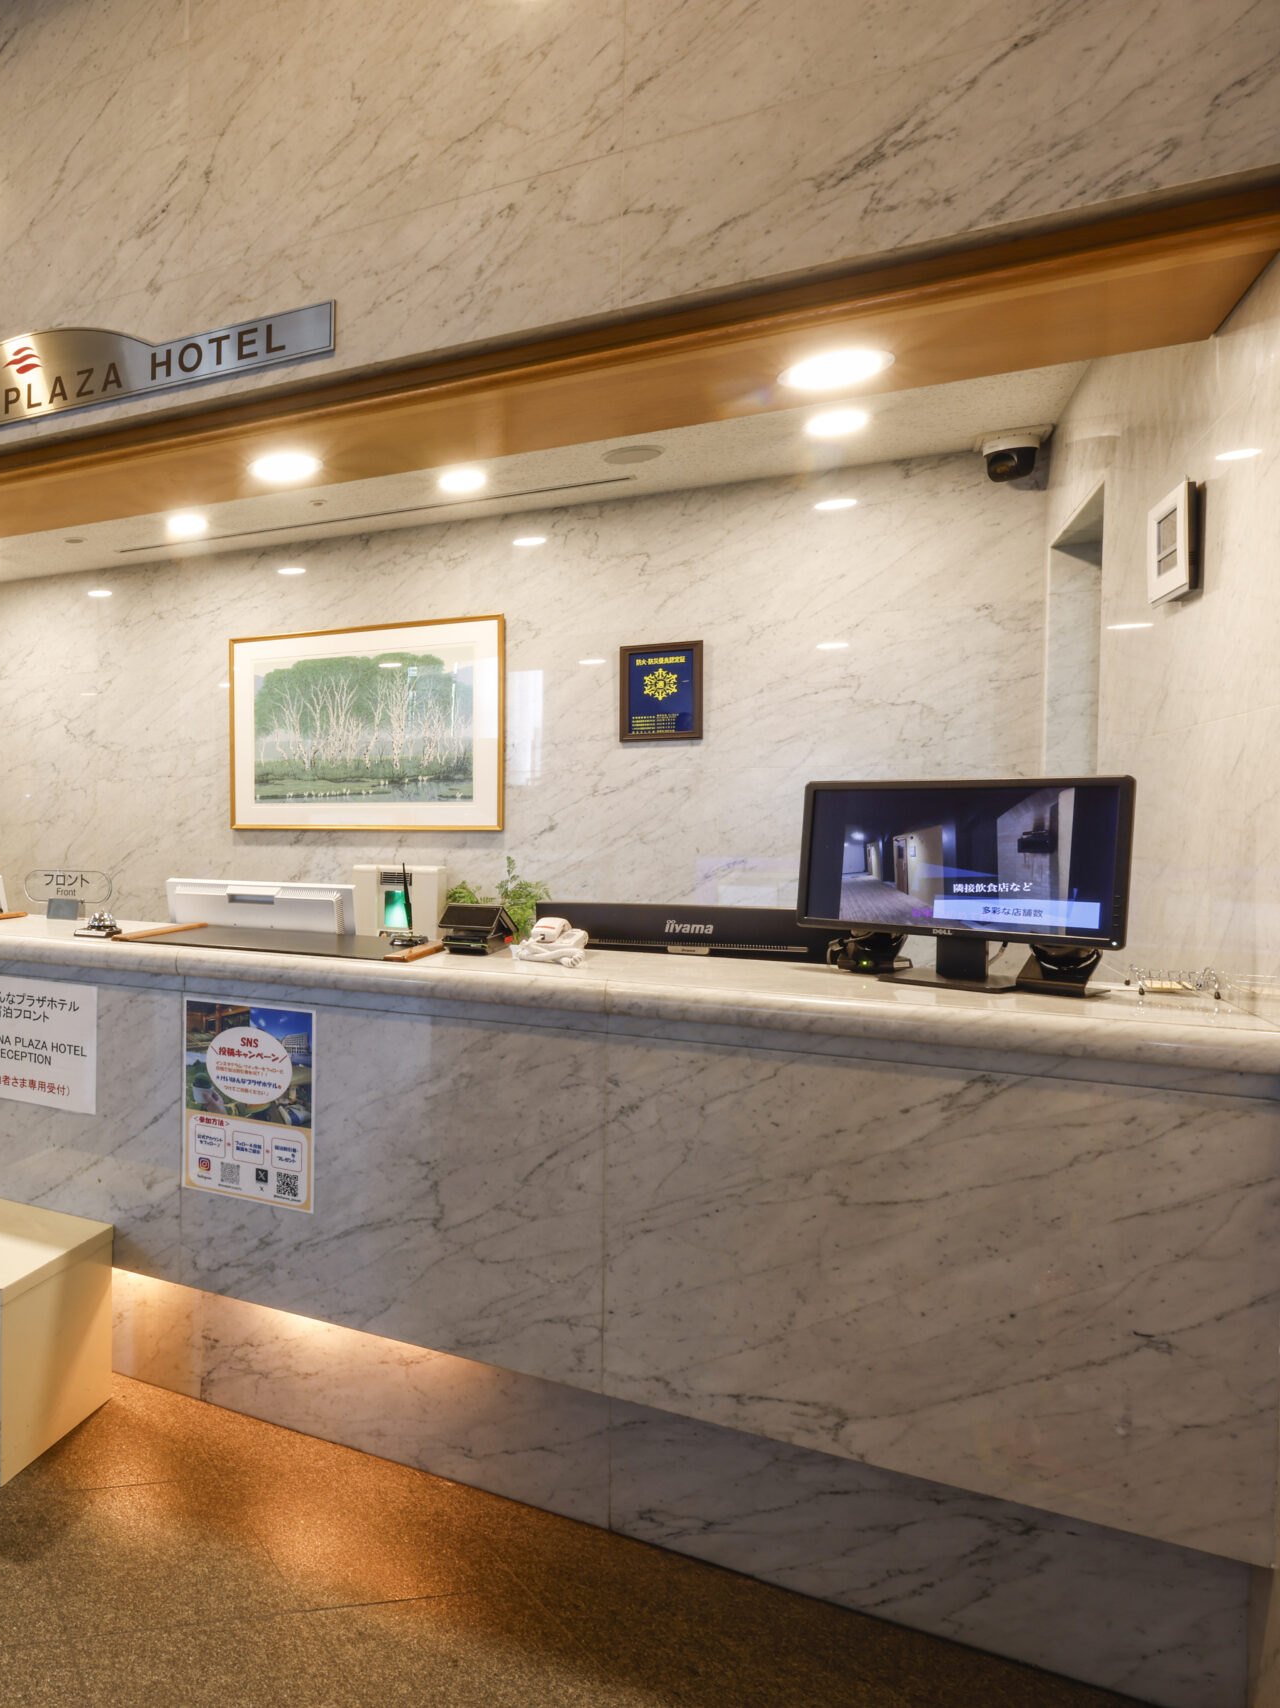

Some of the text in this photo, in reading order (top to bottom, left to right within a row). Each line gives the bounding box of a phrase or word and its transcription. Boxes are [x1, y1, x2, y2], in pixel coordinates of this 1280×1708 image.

[3, 361, 123, 415] PLAZA
[150, 323, 287, 381] HOTEL
[44, 874, 90, 888] フロント
[56, 887, 76, 896] Front
[952, 882, 1033, 894] 隣接飲食店など
[981, 906, 1044, 919] 多彩な店舗数
[664, 919, 714, 935] iiyama
[932, 928, 953, 936] DELL
[14, 1036, 48, 1051] PLAZA
[51, 1042, 88, 1057] HOTEL
[240, 1036, 259, 1048] SNS
